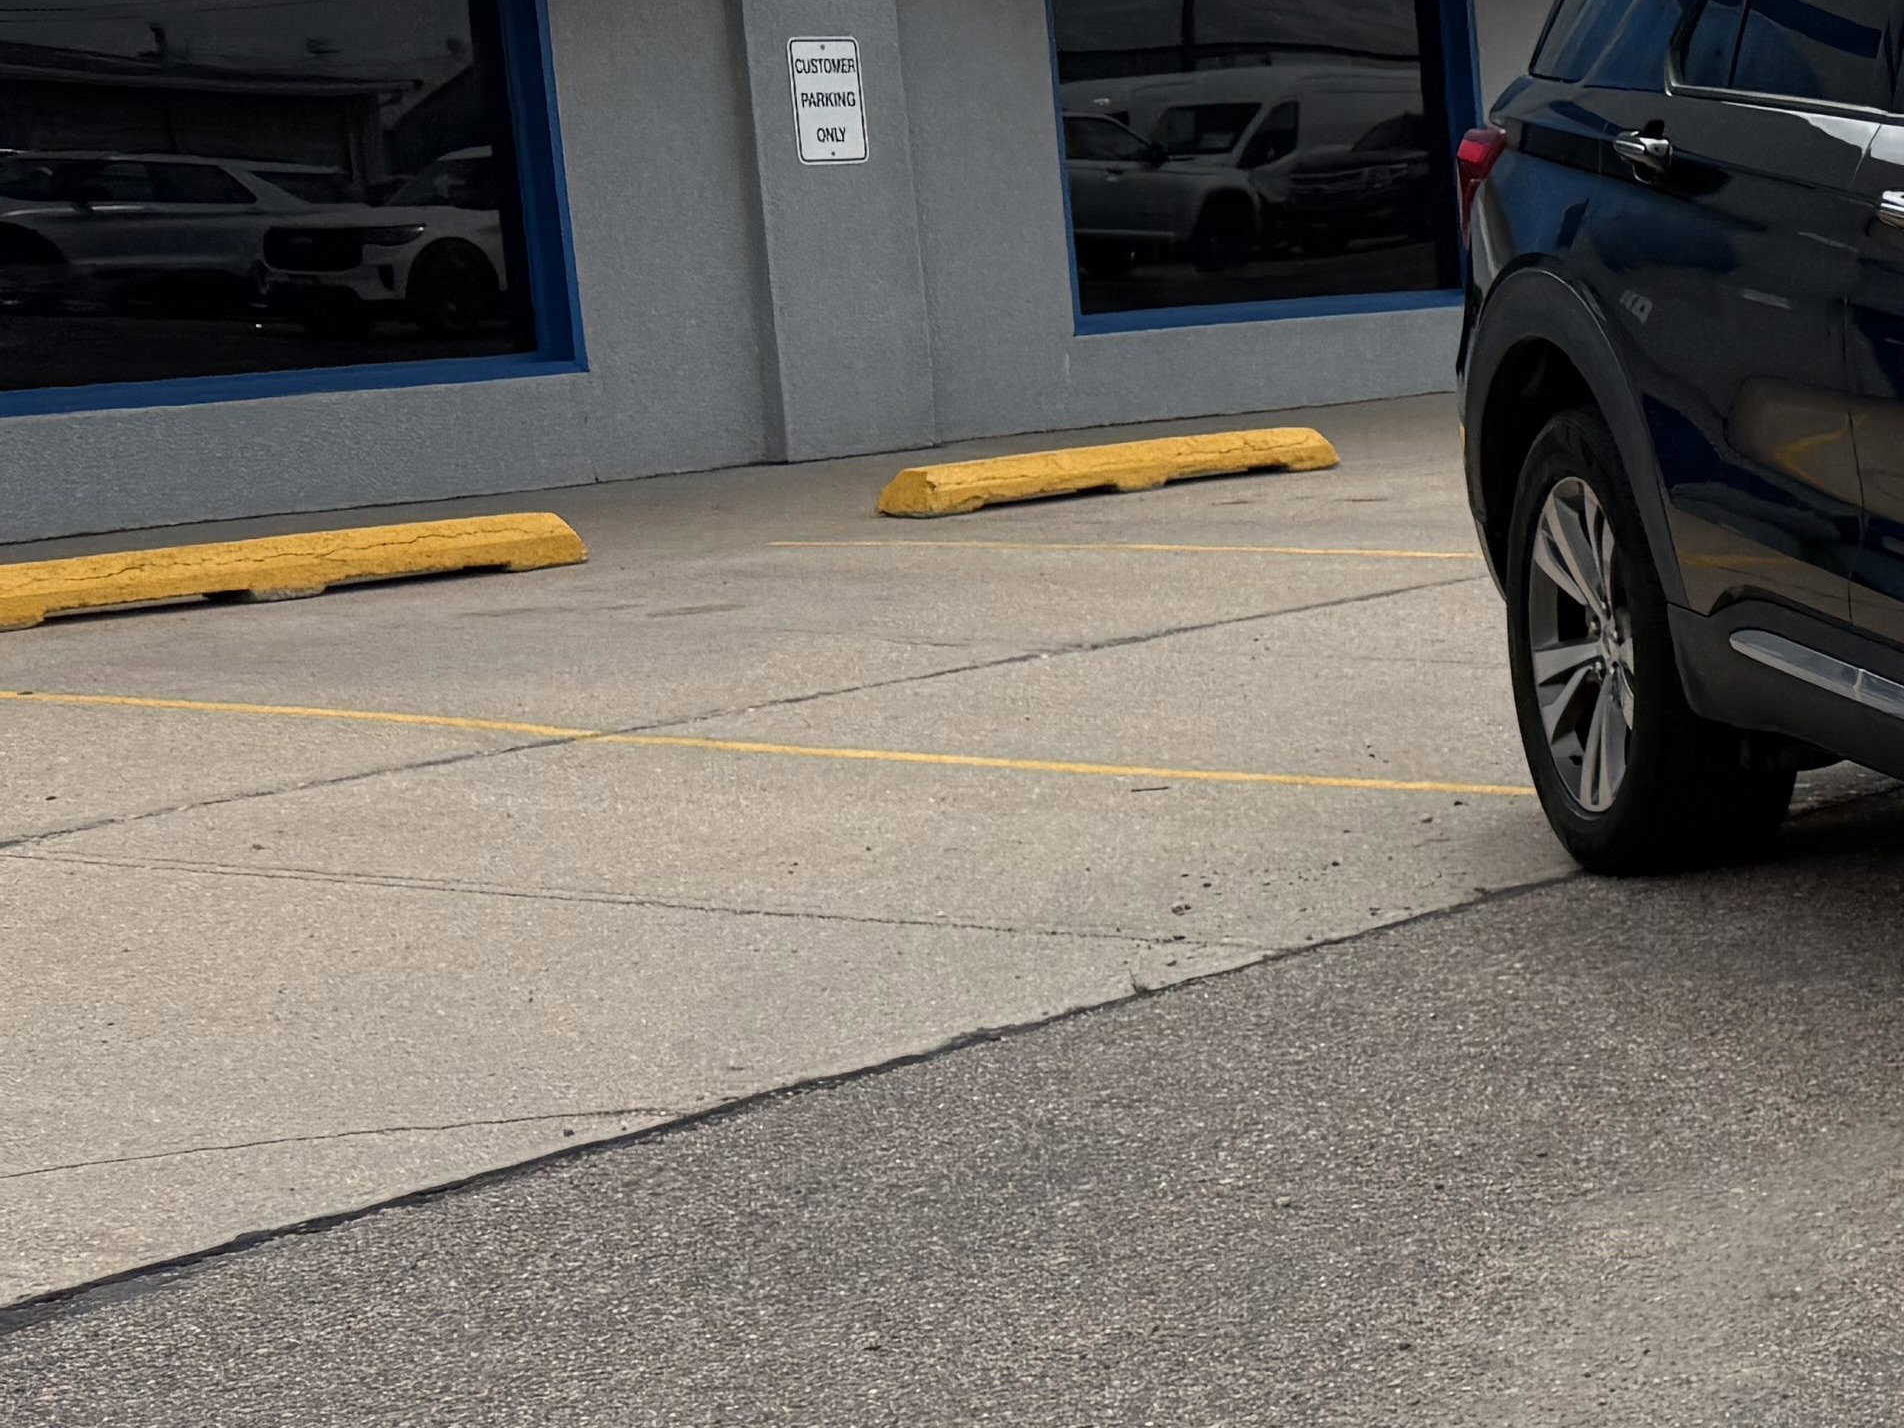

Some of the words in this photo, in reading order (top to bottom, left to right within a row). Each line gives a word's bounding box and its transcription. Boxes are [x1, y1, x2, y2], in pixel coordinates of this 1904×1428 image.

[795, 58, 856, 74] CUSTOMER
[801, 92, 856, 108] PARKING
[816, 127, 846, 143] ONLY
